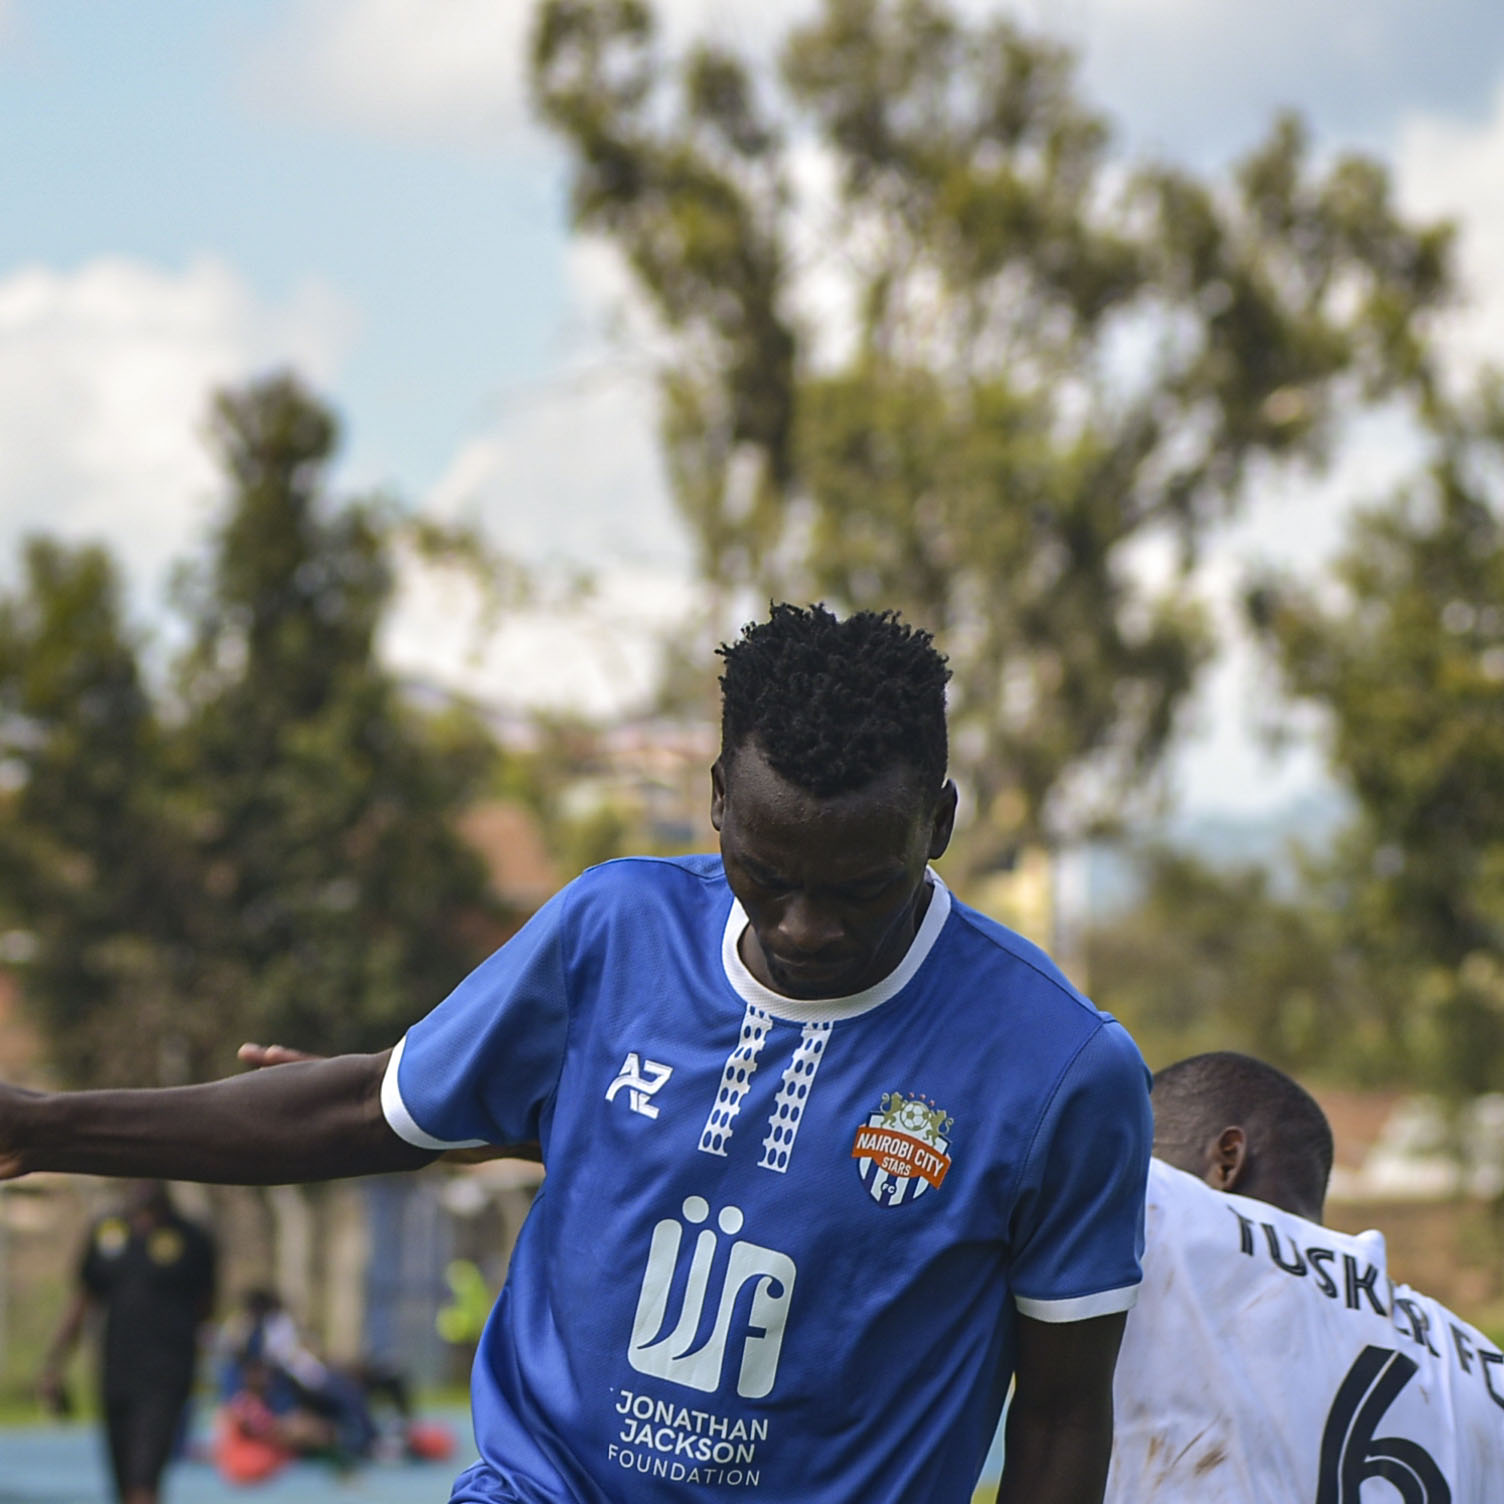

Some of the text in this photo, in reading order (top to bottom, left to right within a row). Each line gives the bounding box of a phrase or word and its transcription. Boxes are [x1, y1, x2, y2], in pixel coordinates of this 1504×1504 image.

[856, 1133, 944, 1177] NAIROBI CITY
[881, 1156, 912, 1176] STARS
[882, 1183, 896, 1194] FC
[1226, 1203, 1441, 1359] TUSKR
[615, 1390, 769, 1441] JONATHAN
[619, 1418, 756, 1464] JACKSON
[607, 1444, 761, 1487] FOUNDATION
